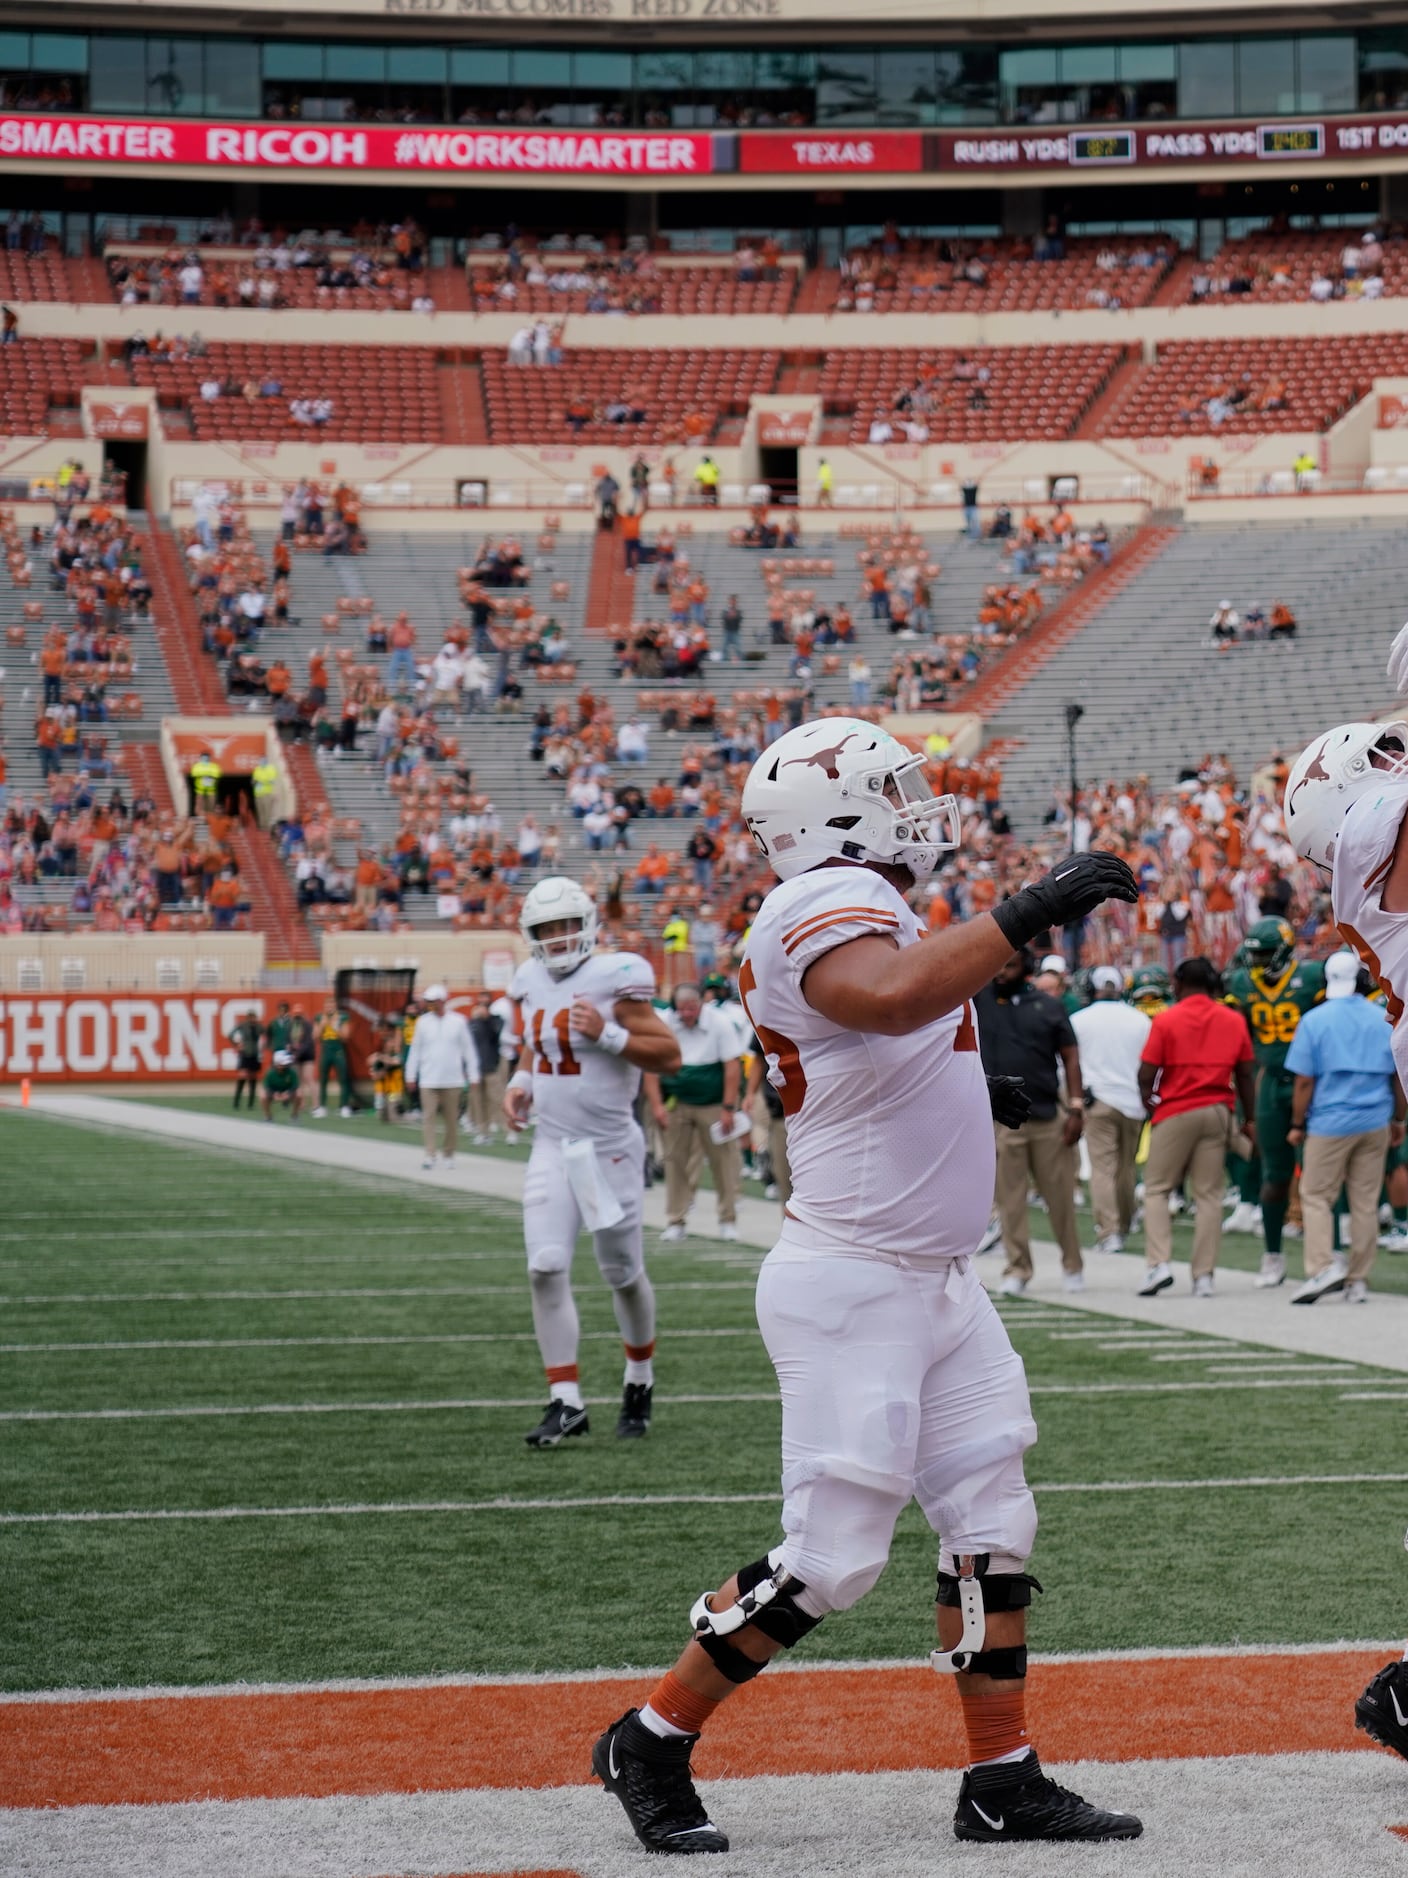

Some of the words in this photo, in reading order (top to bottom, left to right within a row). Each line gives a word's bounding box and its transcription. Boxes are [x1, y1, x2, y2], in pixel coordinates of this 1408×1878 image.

[0, 119, 174, 158] SMARTER
[205, 129, 367, 165] RICOH
[394, 130, 696, 170] #WORKSMARTER
[792, 142, 874, 165] TEXAS
[953, 140, 1018, 164] RUSH
[1019, 136, 1068, 160] YDS
[1146, 134, 1207, 157] PASS
[1208, 131, 1257, 154] YDS
[1337, 127, 1376, 150] 1ST
[0, 999, 263, 1073] HORNS
[532, 1007, 582, 1076] 11
